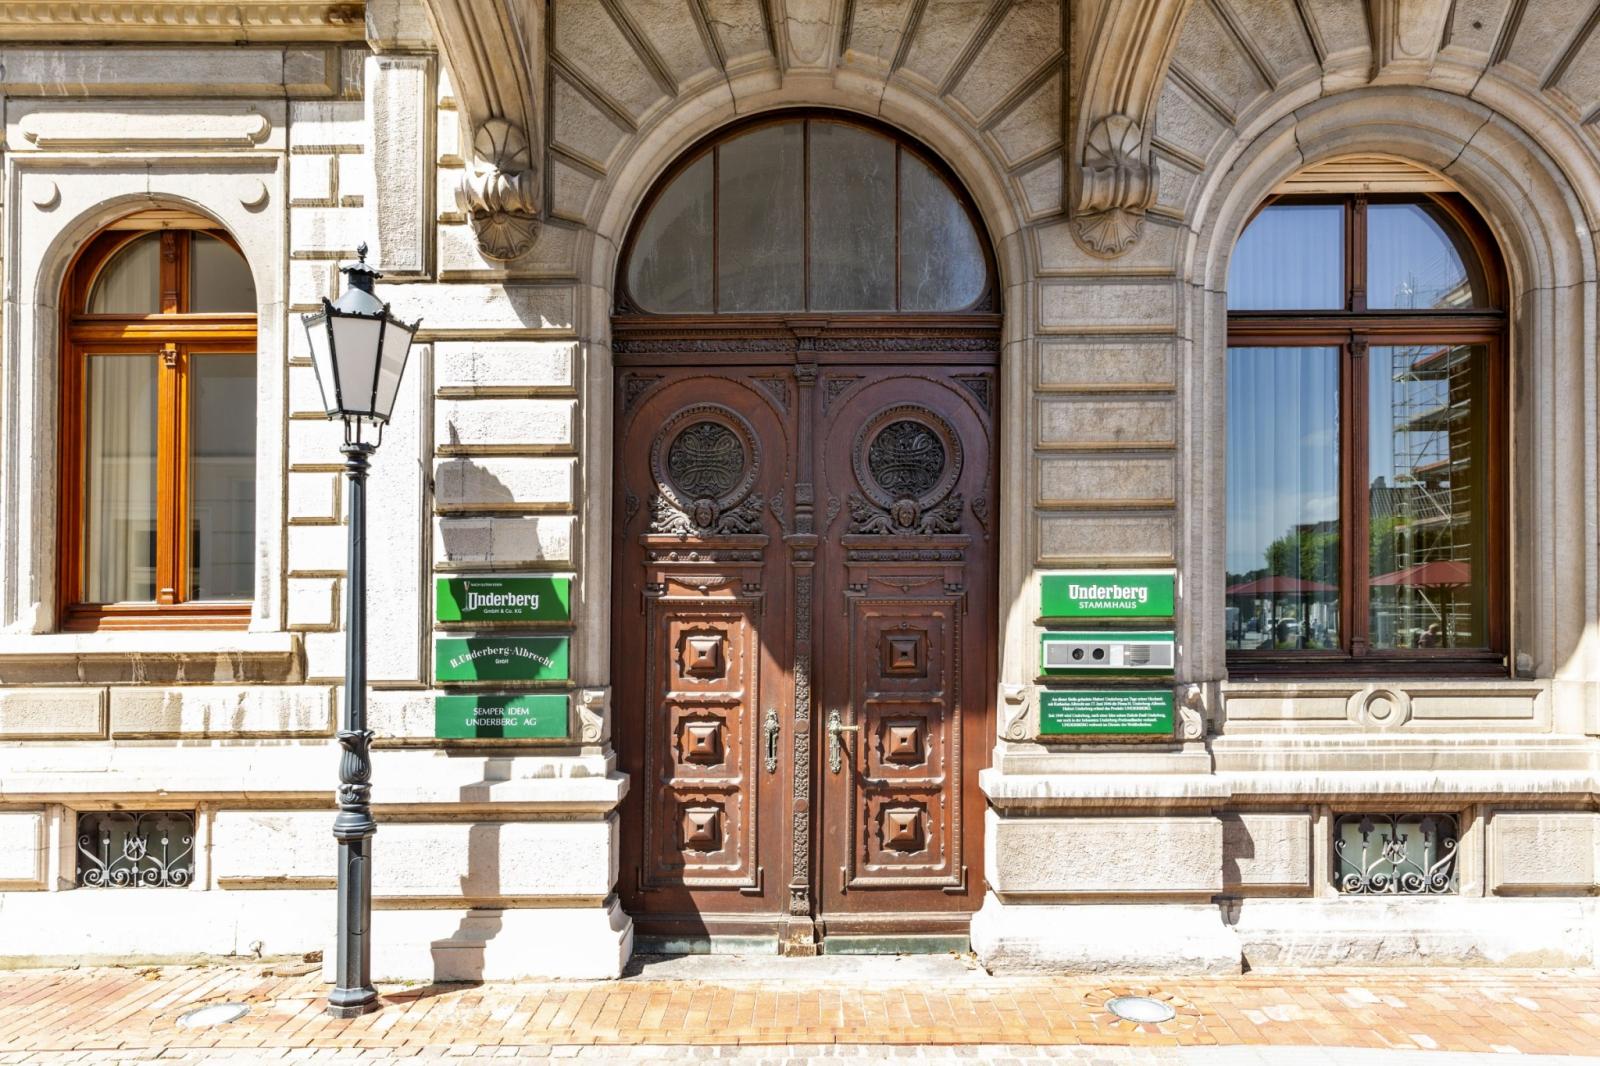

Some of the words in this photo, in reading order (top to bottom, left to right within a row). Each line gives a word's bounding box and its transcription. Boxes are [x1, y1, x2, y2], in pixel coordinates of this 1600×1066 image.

[1068, 584, 1148, 603] Underberg
[468, 592, 540, 610] Underberg
[1079, 601, 1137, 609] STAMMHAUS
[473, 707, 505, 716] SEMPER
[508, 707, 530, 716] IDEM
[465, 718, 518, 727] UNDERBERG
[523, 718, 537, 727] AG
